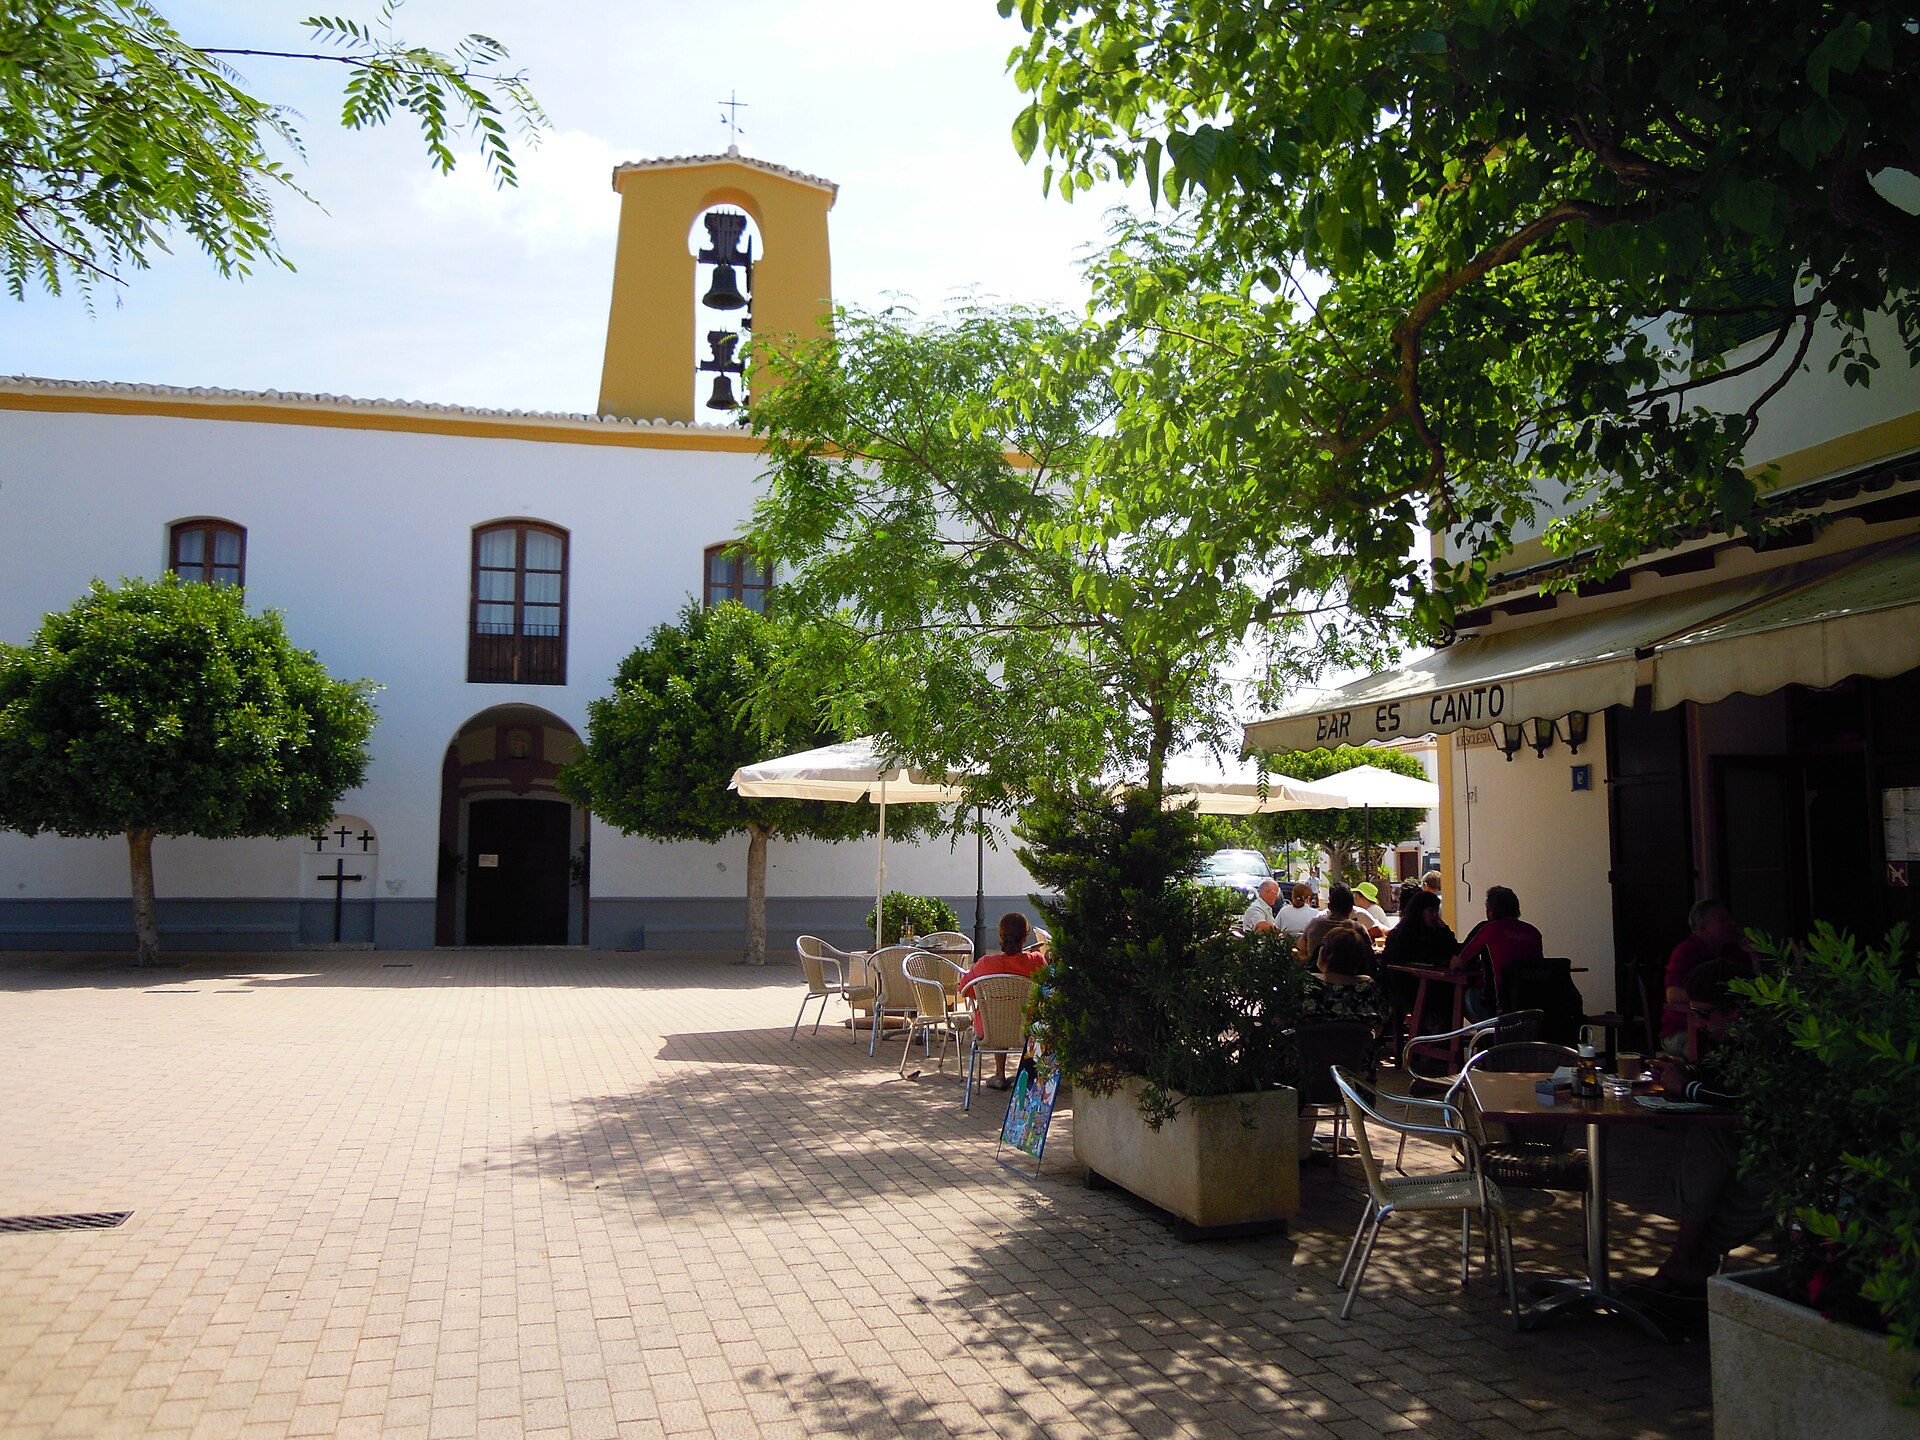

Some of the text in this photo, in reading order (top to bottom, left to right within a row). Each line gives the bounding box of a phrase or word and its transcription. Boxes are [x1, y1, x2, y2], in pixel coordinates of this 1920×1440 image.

[1316, 684, 1505, 741] BAR ES CANTO
